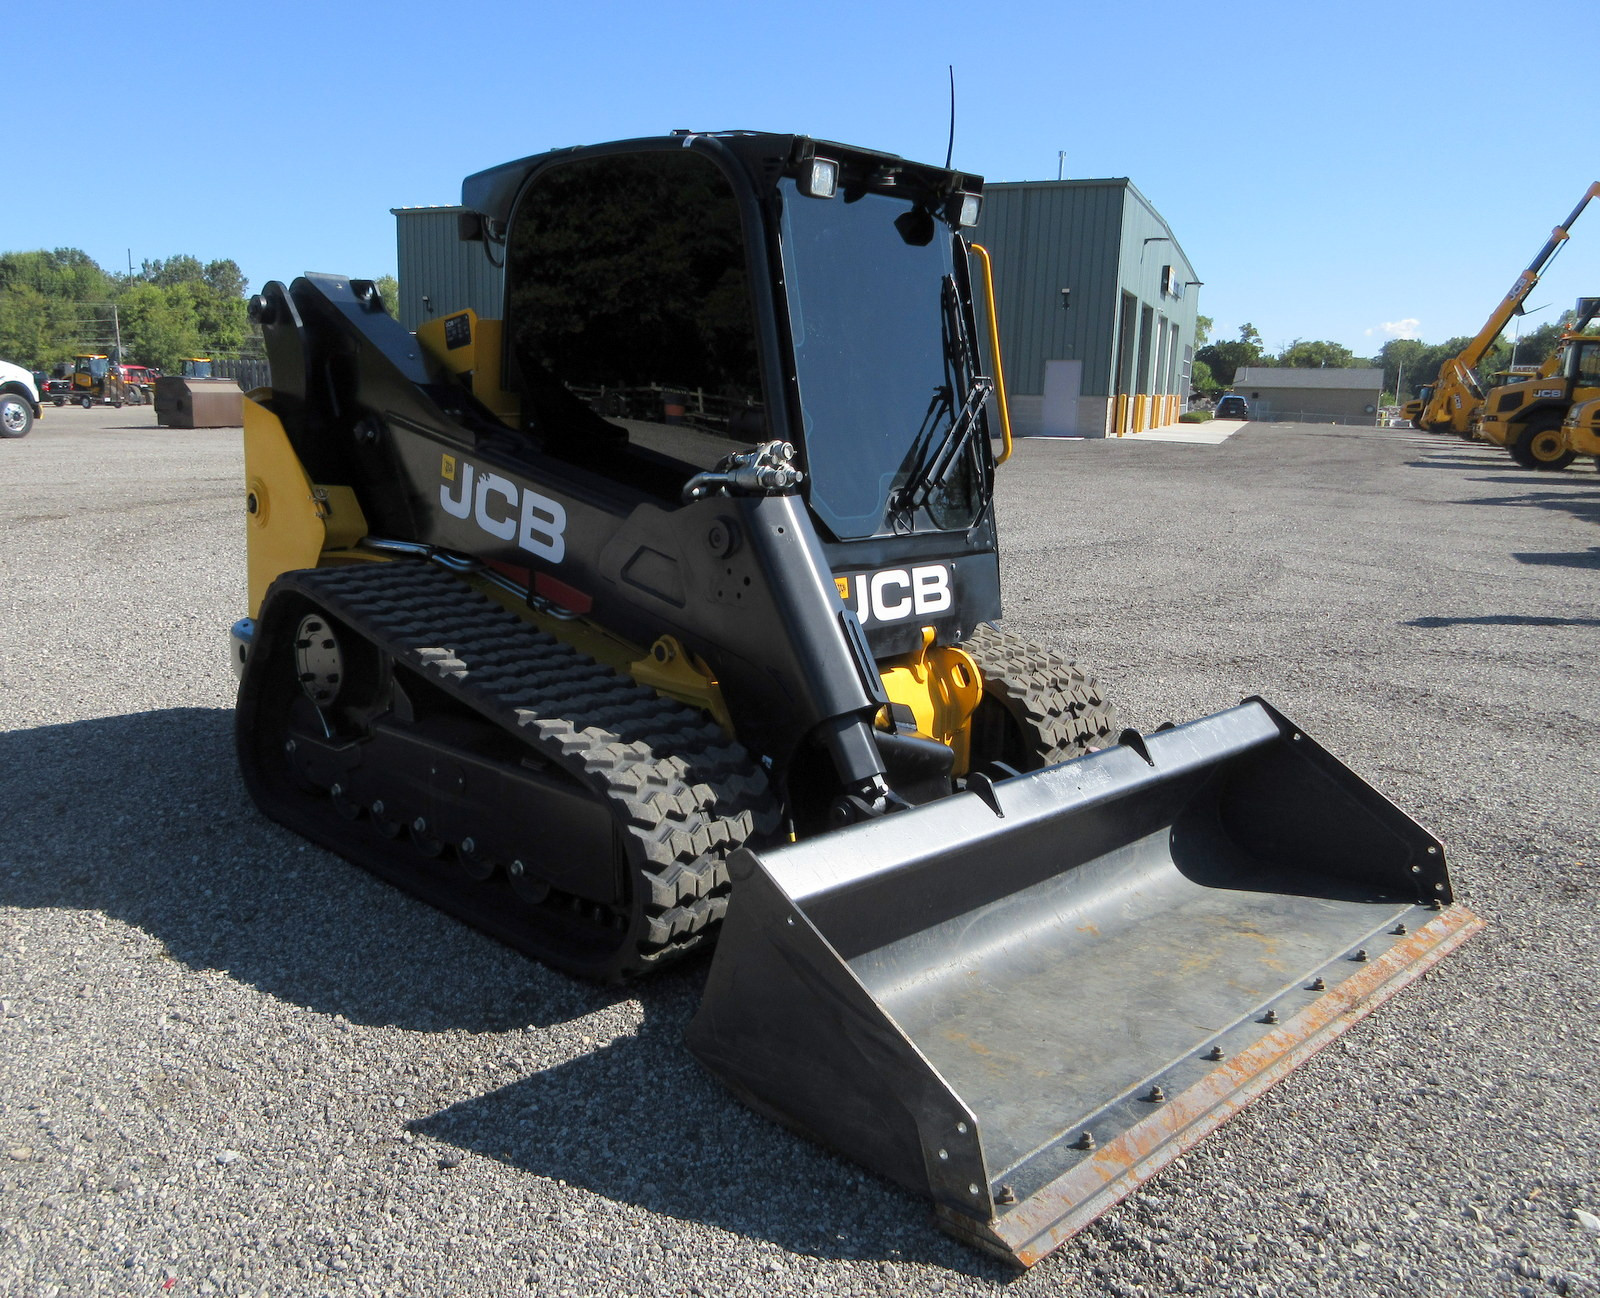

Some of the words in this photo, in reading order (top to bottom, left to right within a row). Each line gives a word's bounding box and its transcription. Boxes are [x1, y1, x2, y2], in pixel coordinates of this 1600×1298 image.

[1509, 278, 1528, 301] JCB
[1533, 389, 1561, 397] JCB
[440, 462, 567, 564] JCB
[855, 564, 951, 625] JCB
